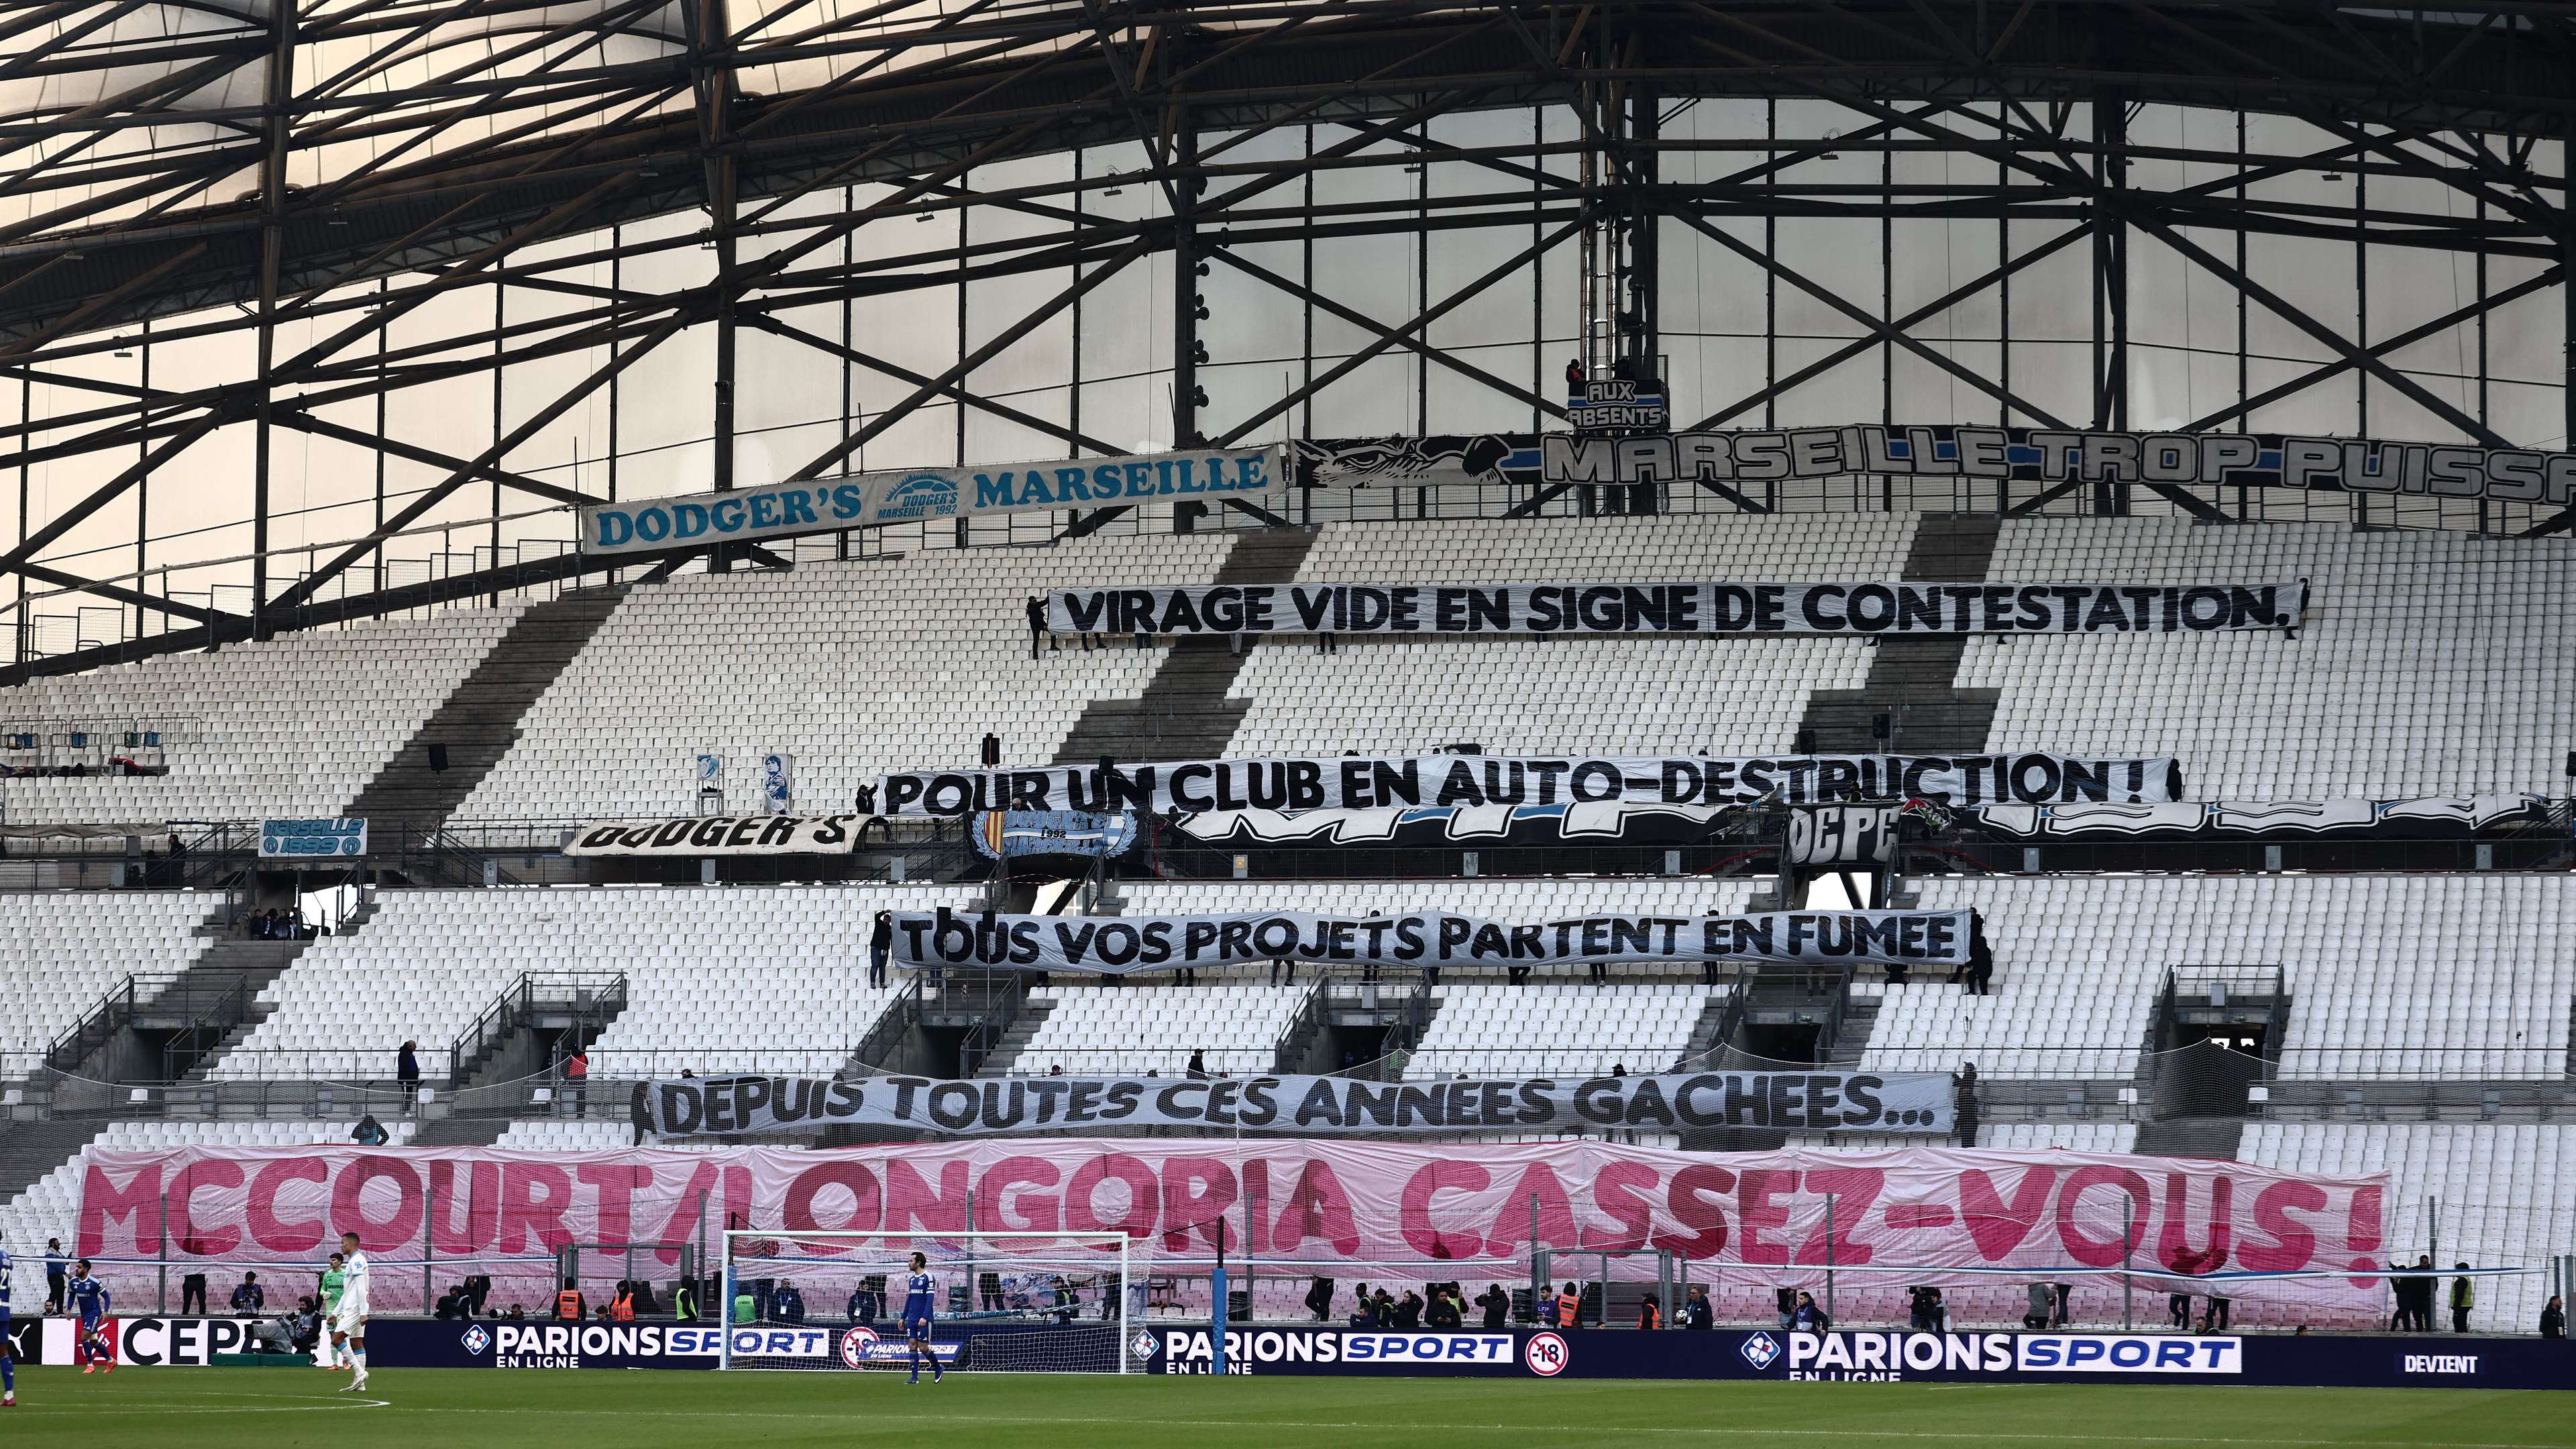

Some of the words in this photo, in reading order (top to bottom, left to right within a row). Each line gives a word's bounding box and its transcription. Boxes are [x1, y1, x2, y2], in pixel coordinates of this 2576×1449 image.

[1587, 381, 1635, 402] AUX
[1567, 406, 1664, 428] ABSENTS
[1542, 424, 2011, 484] MARSEILLE
[2027, 430, 2260, 487] TROP
[596, 484, 862, 547] DODGER'S
[972, 453, 1269, 509] MARSEILLE
[877, 506, 925, 520] MARSEILLE
[935, 504, 957, 515] 1992
[902, 492, 958, 507] DODGER'S
[1063, 588, 1275, 634] VIRAGE
[1291, 586, 1420, 631] VIDE
[1436, 588, 1515, 631] EN
[1526, 586, 1698, 632] SIGNE
[1715, 584, 1785, 631] DE
[1801, 583, 2290, 632] CONTESTATION.
[884, 771, 1052, 816] POUR
[1067, 769, 1155, 812] UN
[1169, 760, 1326, 811] CLUB
[1342, 759, 1420, 807] EN
[1436, 758, 2115, 807] AUTO-DESTRUCTION
[580, 814, 857, 848] DODGER'S
[1040, 829, 1067, 839] 1992
[280, 837, 339, 854] 1899
[900, 919, 1040, 964] TOUS
[1053, 921, 1174, 966] VOS
[1184, 916, 1426, 961] PROJETS
[1438, 916, 1690, 961] PARTENT
[1703, 915, 1775, 956] EN
[1787, 914, 1957, 959] FUMEE
[660, 1075, 868, 1134] DEPUIS
[886, 1075, 1146, 1130] TOUTES
[1155, 1076, 1281, 1126] CES
[1295, 1076, 1556, 1128] ANNEES
[1572, 1074, 1936, 1129] GACHEES...
[496, 1326, 661, 1356] PARIONS
[671, 1330, 825, 1354] SPORT
[873, 1344, 912, 1354] PARION
[1166, 1332, 1338, 1362] PARIONS
[1346, 1336, 1509, 1361] SPORT
[1789, 1332, 2012, 1372] PARIONS
[2025, 1340, 2237, 1369] SPORT
[496, 1356, 519, 1368] EN
[527, 1356, 579, 1368] LIGNE
[1166, 1362, 1189, 1375] EN
[1197, 1362, 1252, 1375] LINE
[2404, 1355, 2478, 1374] DEVIENT
